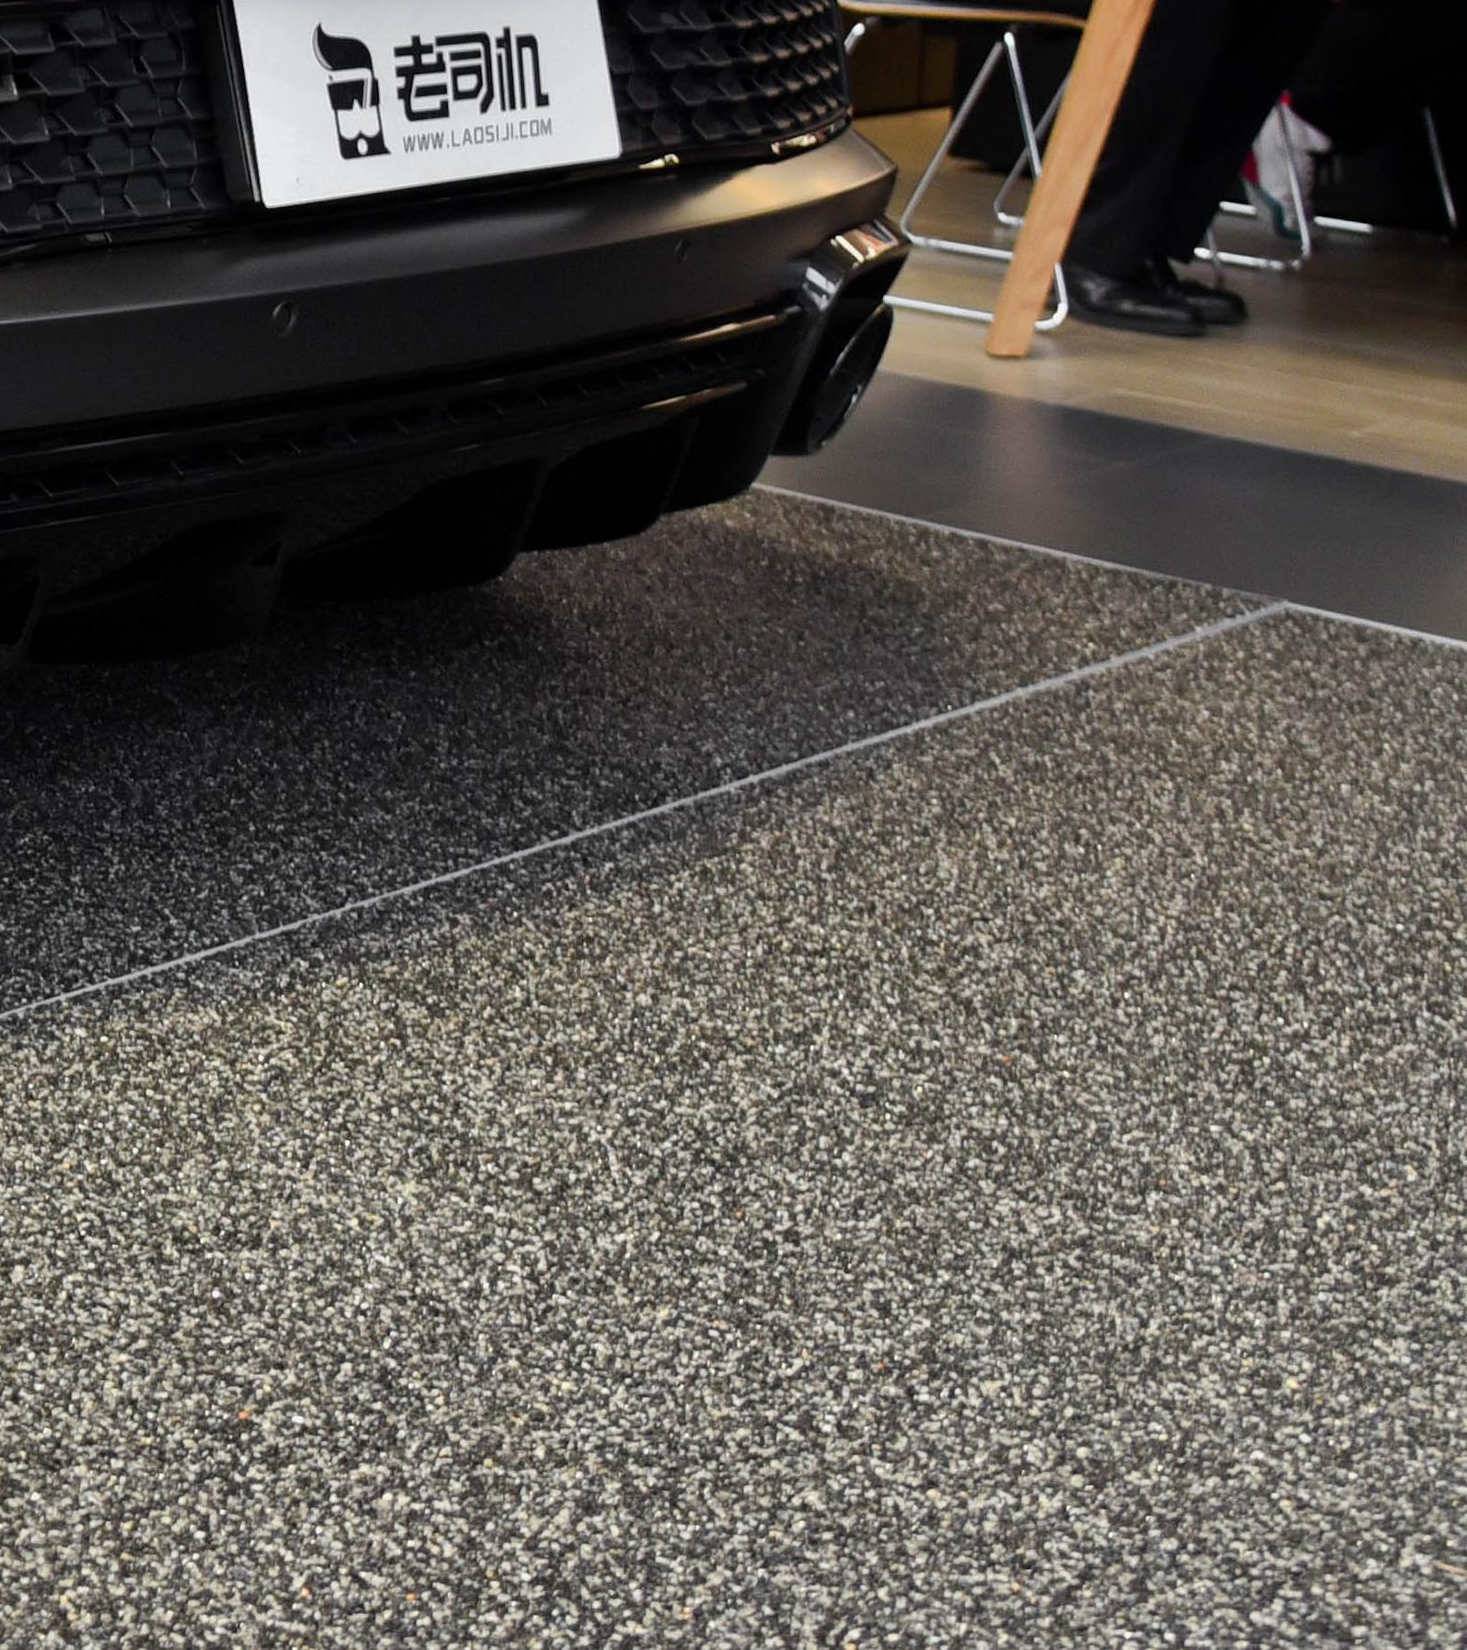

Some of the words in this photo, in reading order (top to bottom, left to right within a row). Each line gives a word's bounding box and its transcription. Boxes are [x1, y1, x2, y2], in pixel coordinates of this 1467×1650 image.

[393, 26, 550, 122] 老司机
[403, 118, 553, 154] WWW.LAOSIJI.COM
